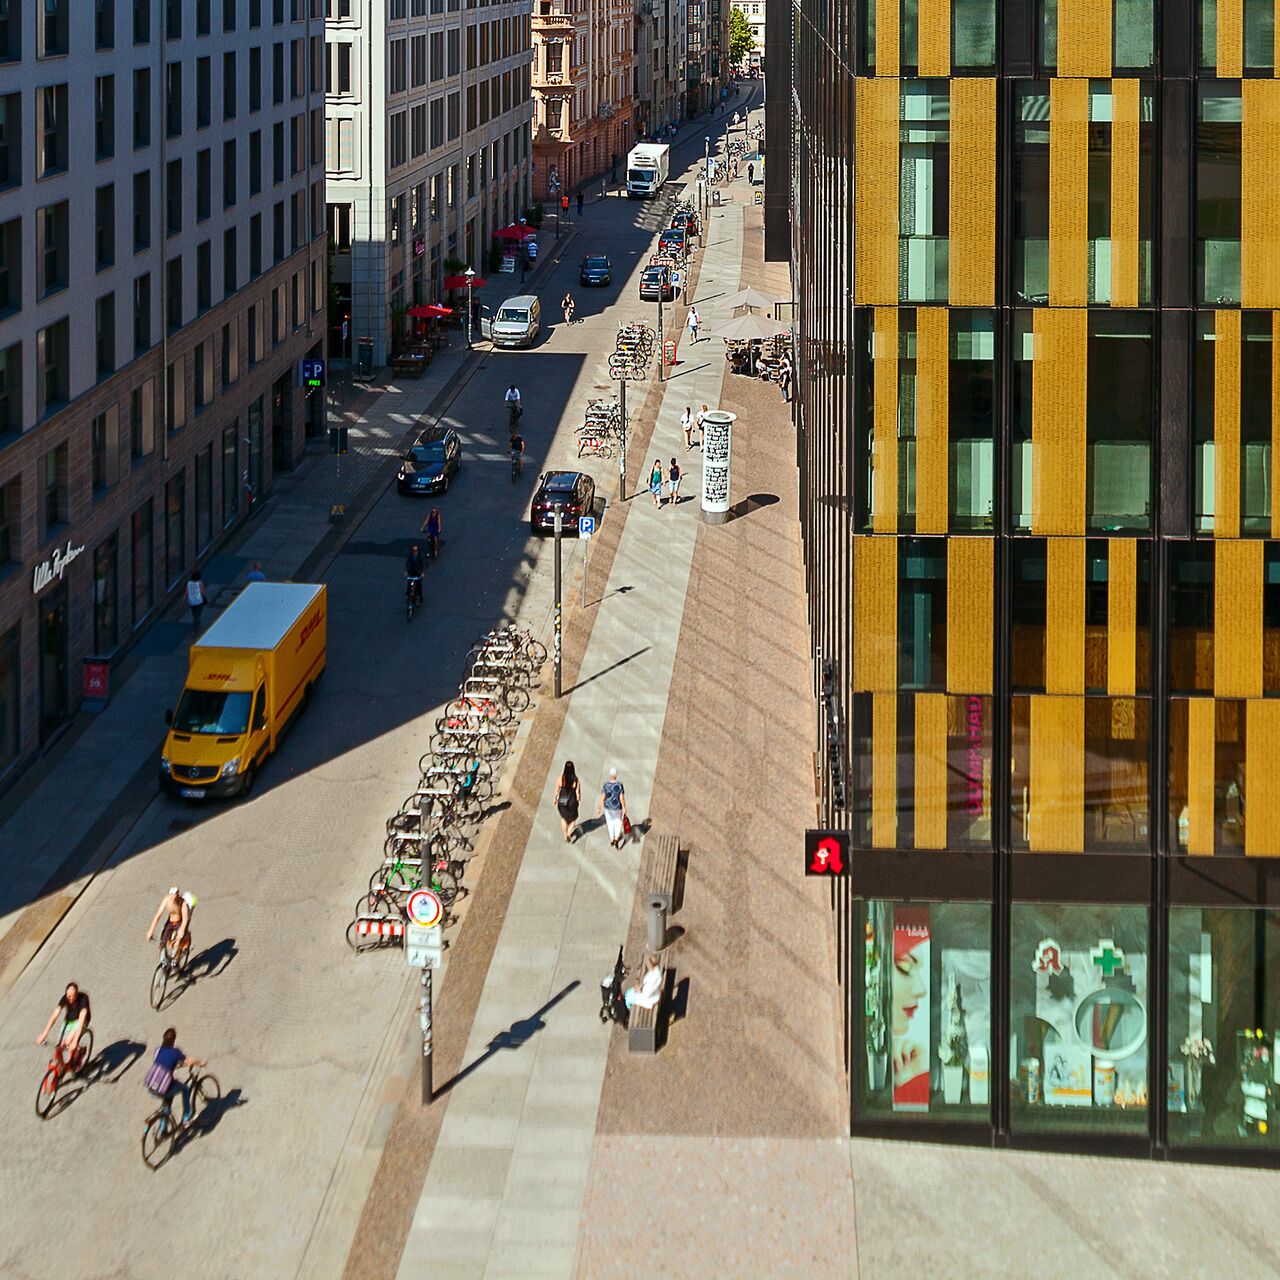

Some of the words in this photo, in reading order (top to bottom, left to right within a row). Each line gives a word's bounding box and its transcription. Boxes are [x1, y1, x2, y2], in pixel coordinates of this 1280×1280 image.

[313, 364, 322, 378] P
[583, 521, 592, 531] P
[298, 607, 324, 647] DHL
[205, 673, 235, 682] DHL
